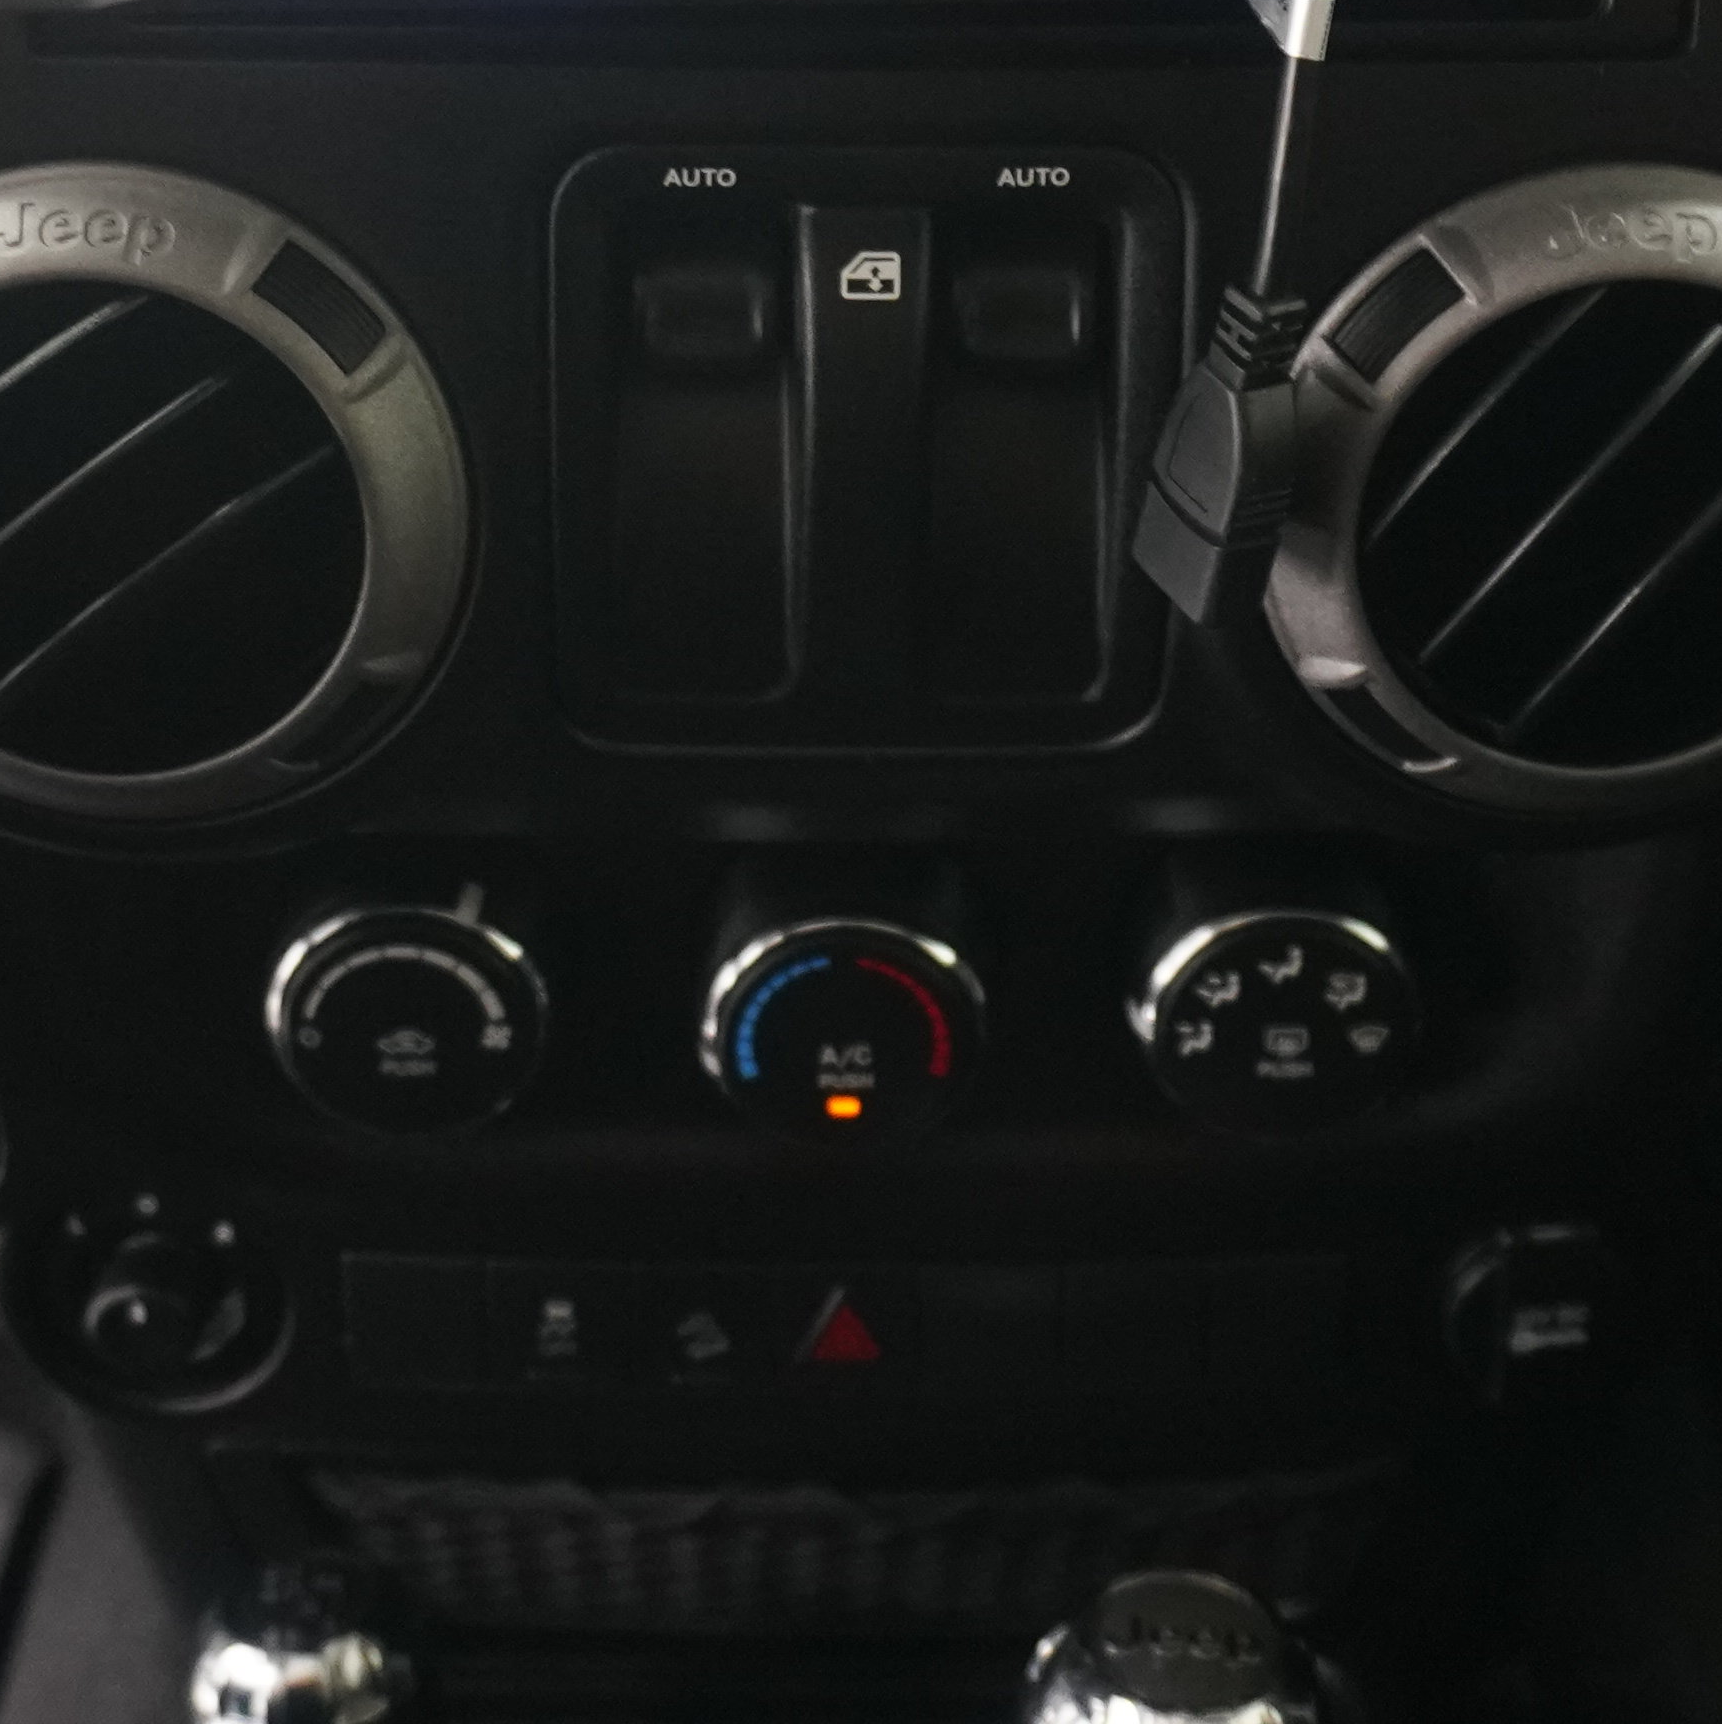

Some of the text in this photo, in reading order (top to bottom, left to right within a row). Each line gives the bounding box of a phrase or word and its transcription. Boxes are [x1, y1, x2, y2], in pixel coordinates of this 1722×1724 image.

[663, 167, 738, 188] AUTO
[997, 166, 1072, 188] AUTO
[1545, 202, 1719, 265] Jeep
